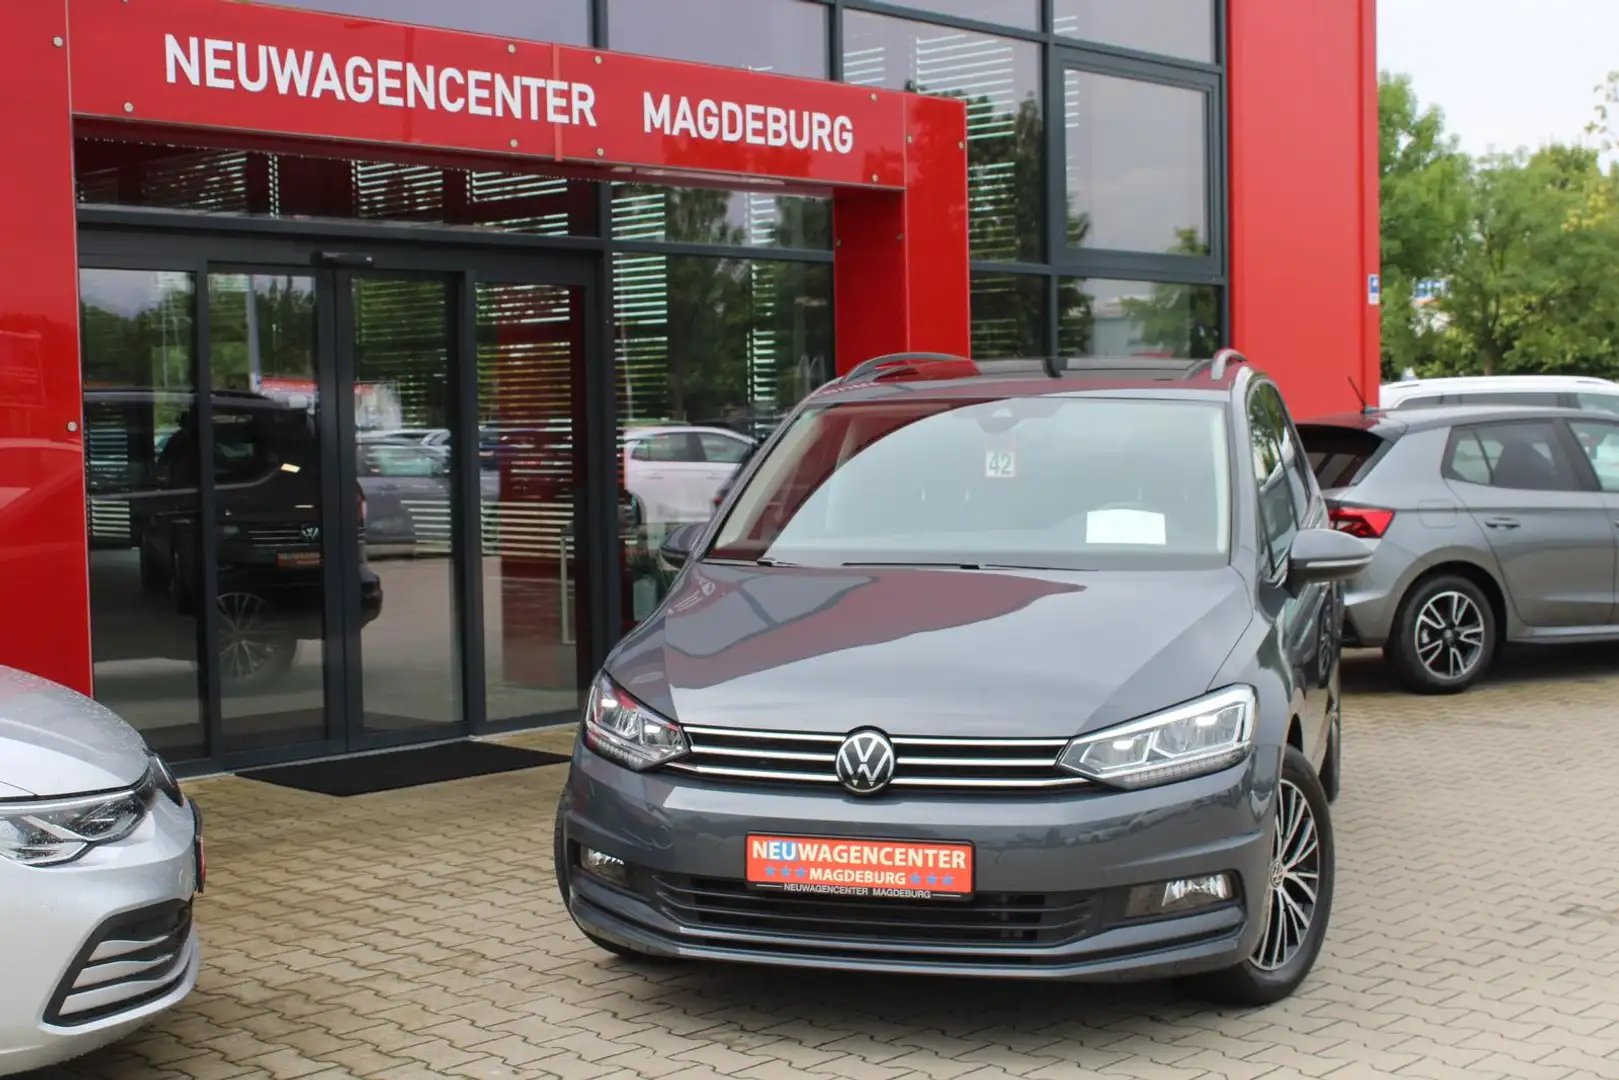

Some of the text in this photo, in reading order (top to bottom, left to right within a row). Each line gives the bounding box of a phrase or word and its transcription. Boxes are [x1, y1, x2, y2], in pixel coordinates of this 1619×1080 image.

[165, 34, 853, 154] NEUWAGENCENTER MAGDEBURG
[989, 452, 1012, 475] 42
[751, 840, 967, 869] NEUWAGENCENTER
[809, 867, 906, 885] MAGDEBURG
[783, 882, 931, 899] NEUWAGENCENTER MAGDEBURG
